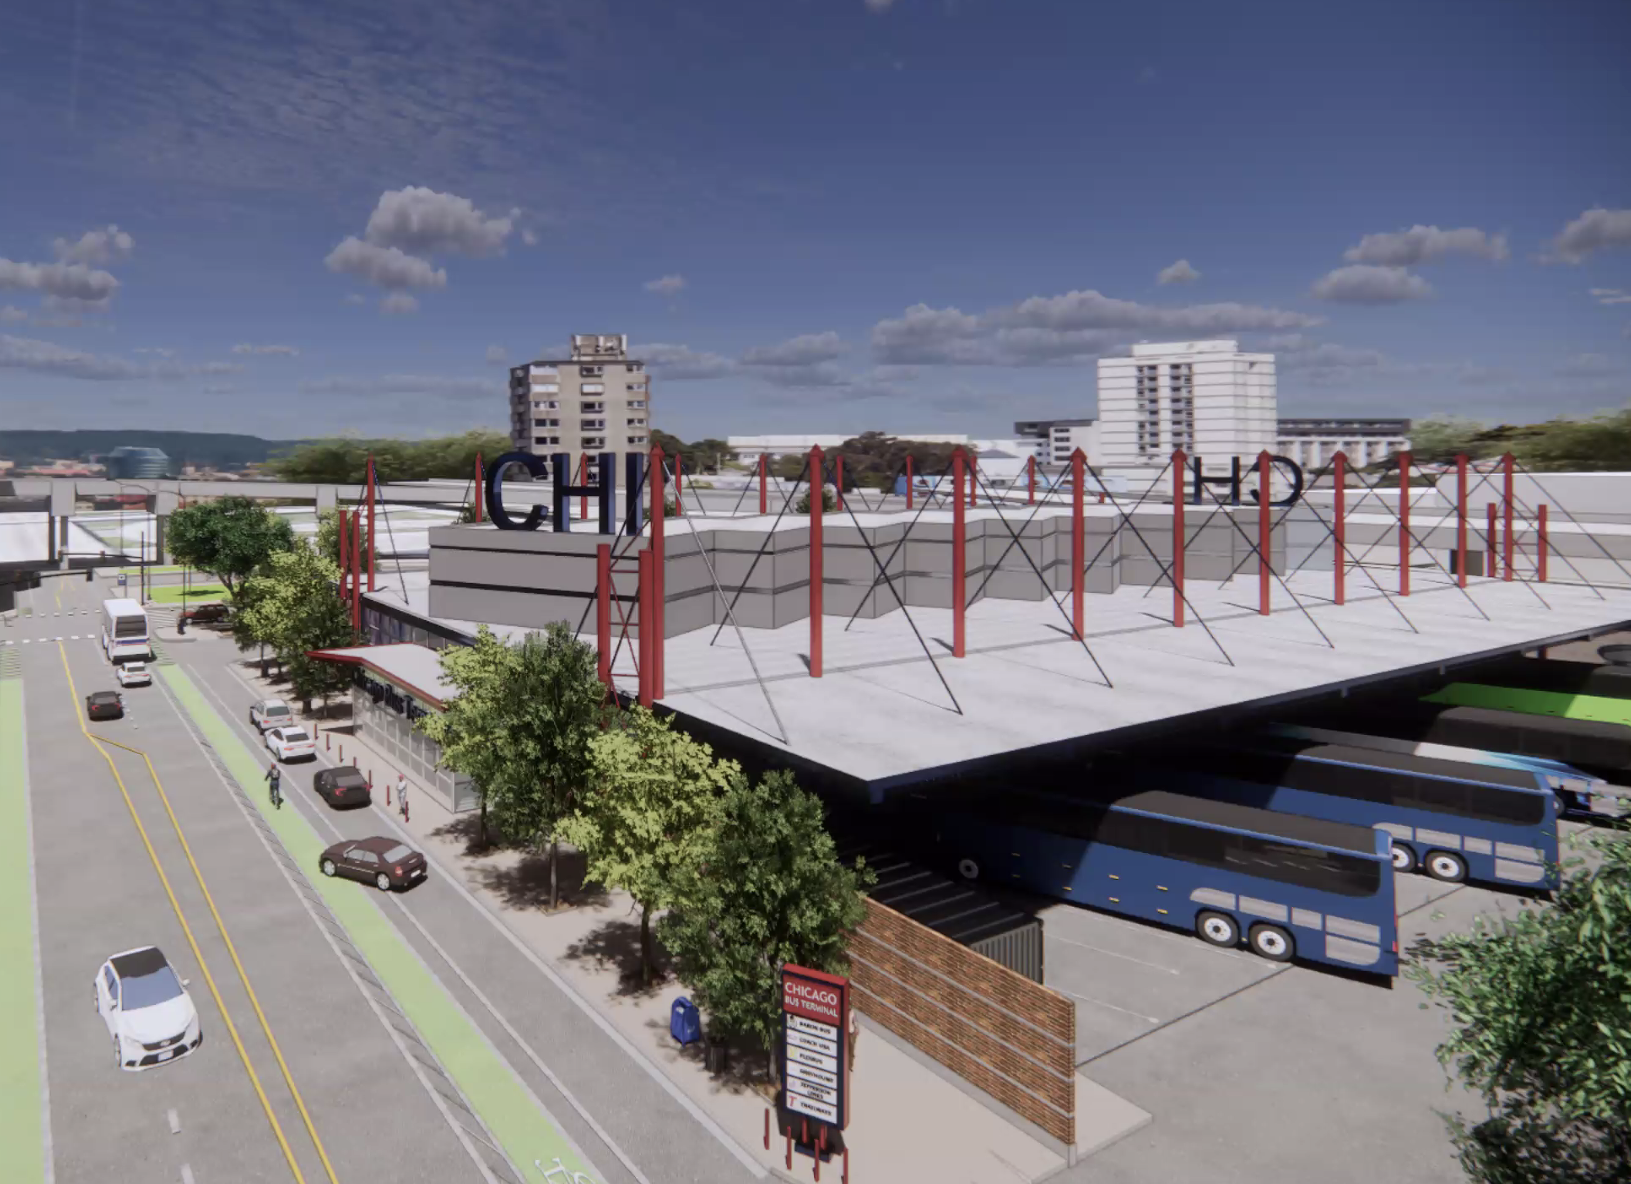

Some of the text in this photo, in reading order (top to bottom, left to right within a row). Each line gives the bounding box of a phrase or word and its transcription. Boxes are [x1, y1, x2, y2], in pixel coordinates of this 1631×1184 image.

[485, 451, 643, 536] CHI
[785, 982, 837, 1006] CHICAGO
[785, 995, 838, 1018] BUS TERMINAL
